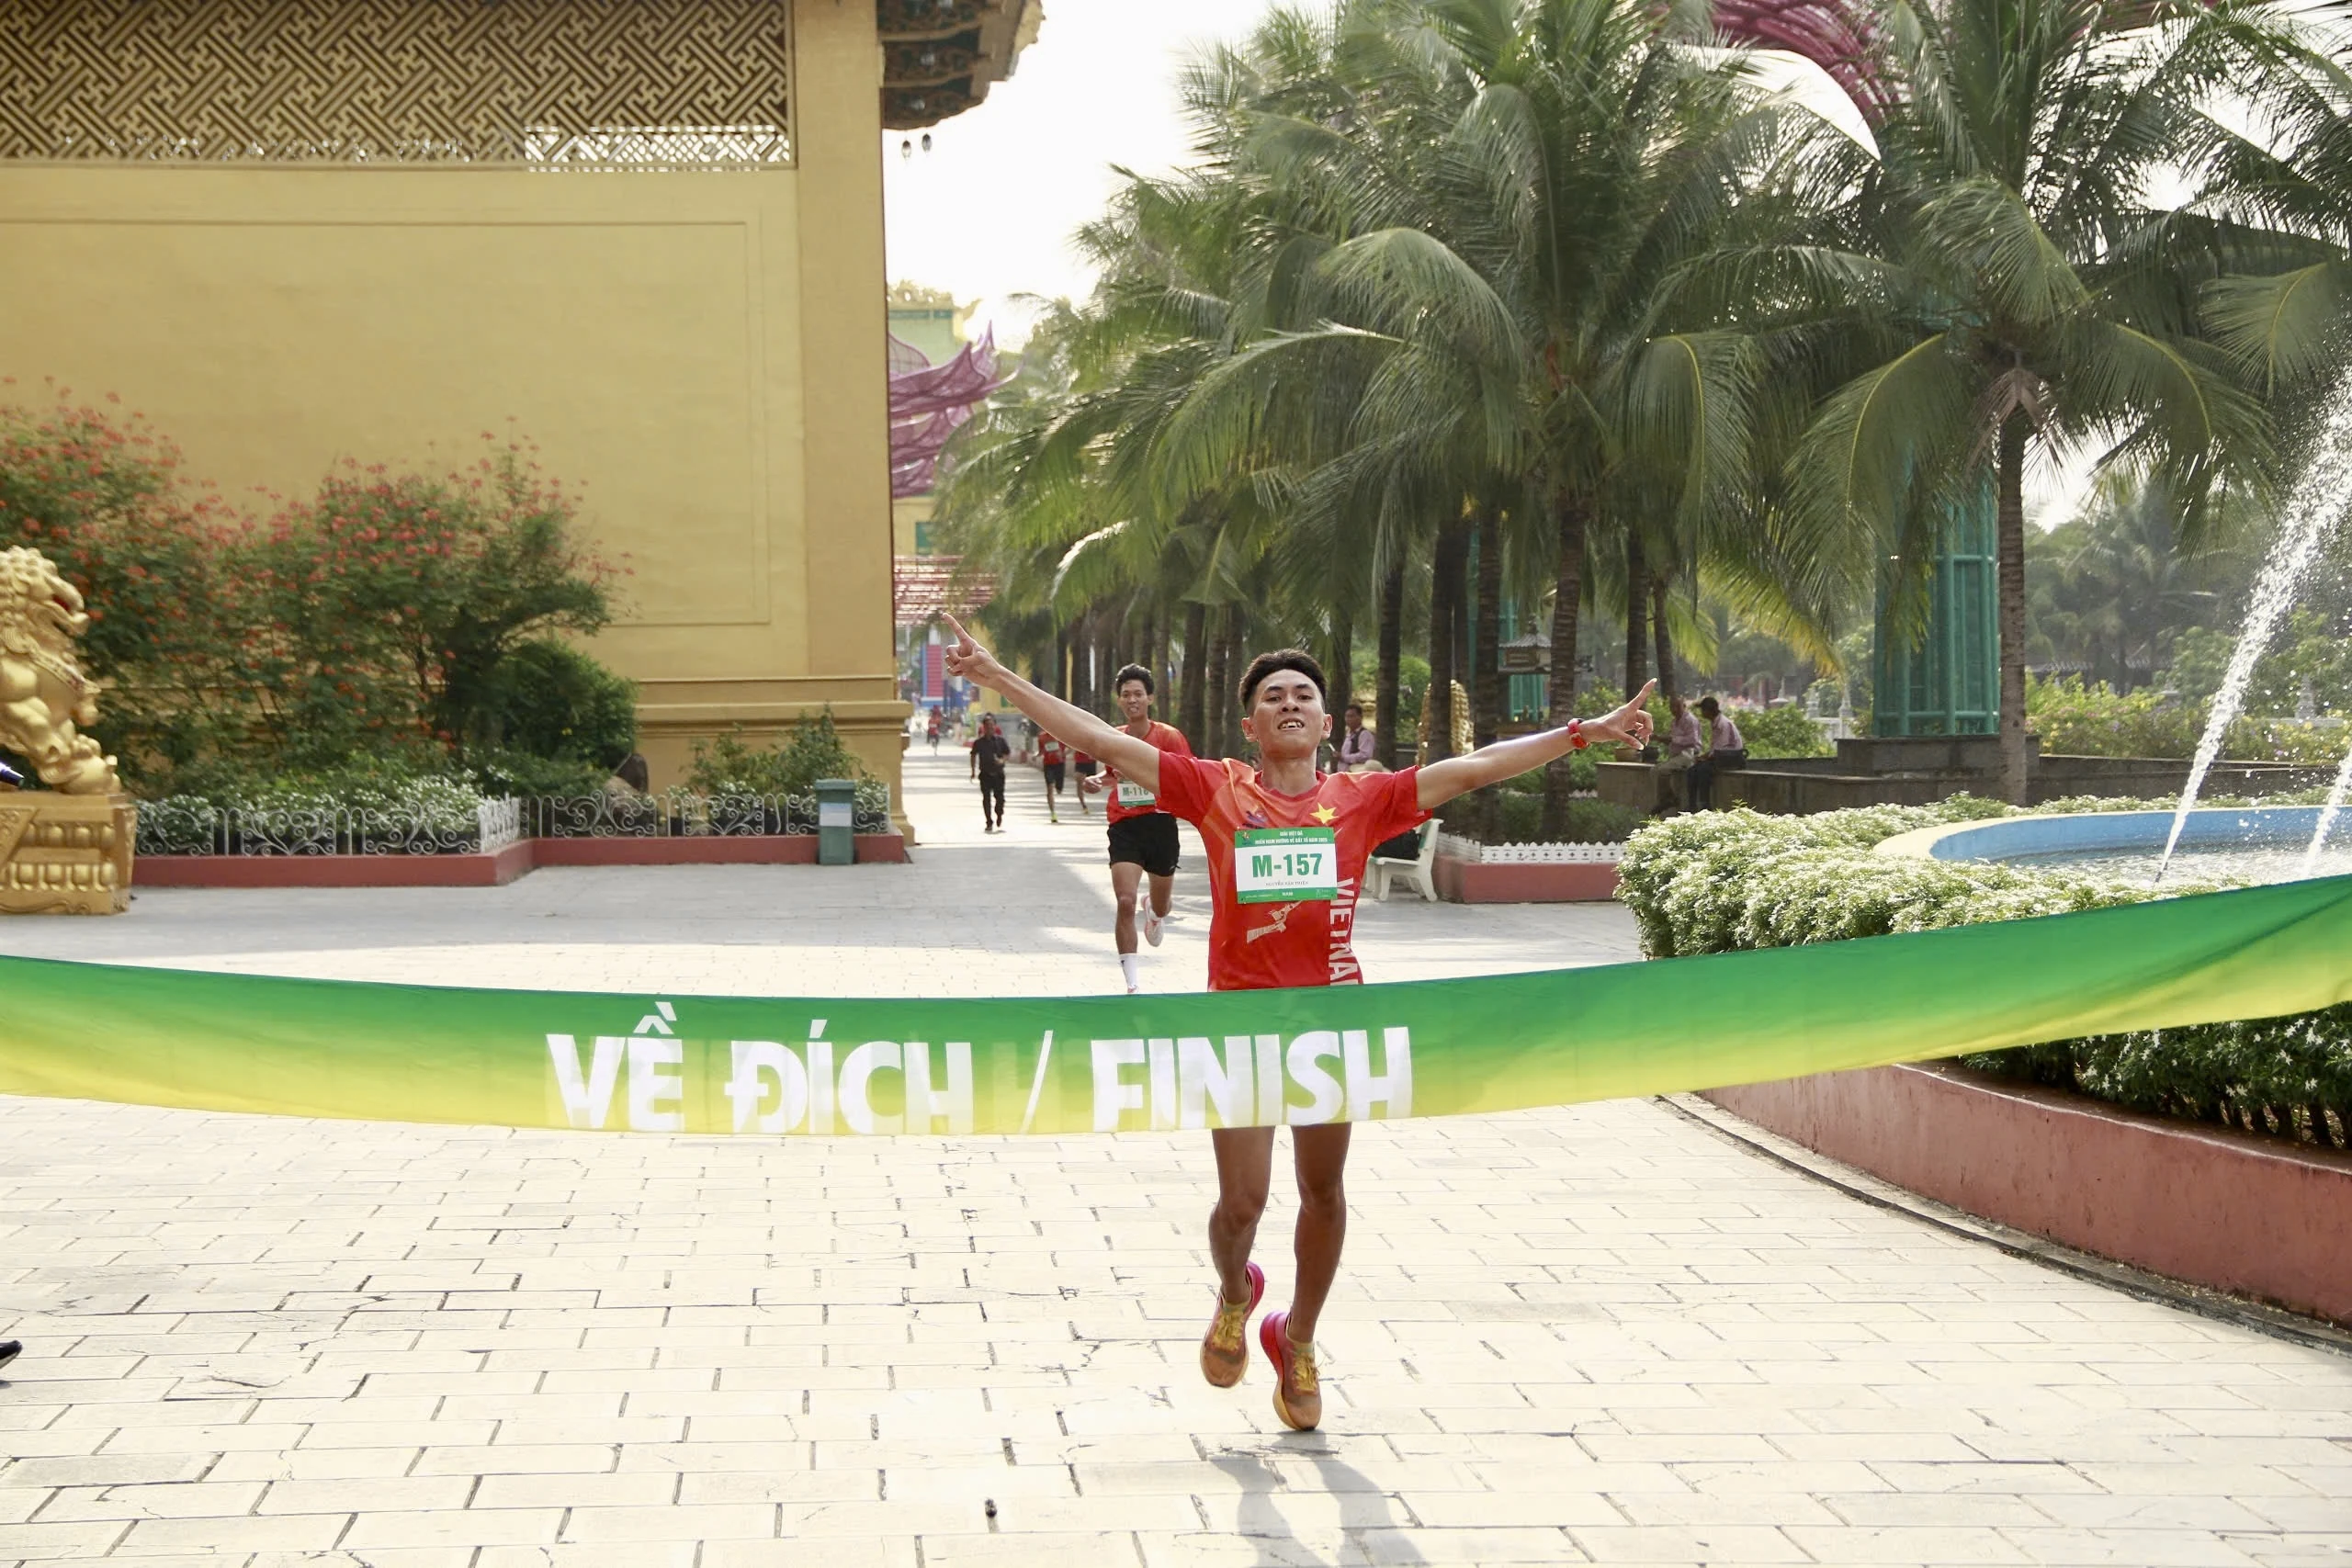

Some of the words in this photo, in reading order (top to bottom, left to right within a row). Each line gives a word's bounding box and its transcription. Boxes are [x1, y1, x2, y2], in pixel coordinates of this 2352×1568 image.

[1252, 852, 1323, 878] M-157
[1329, 877, 1359, 986] VIETNA
[546, 1000, 684, 1131] VỀ
[724, 1019, 973, 1134] ĐÍCH
[1021, 1030, 1053, 1134] /
[1090, 1026, 1413, 1133] FINISH
